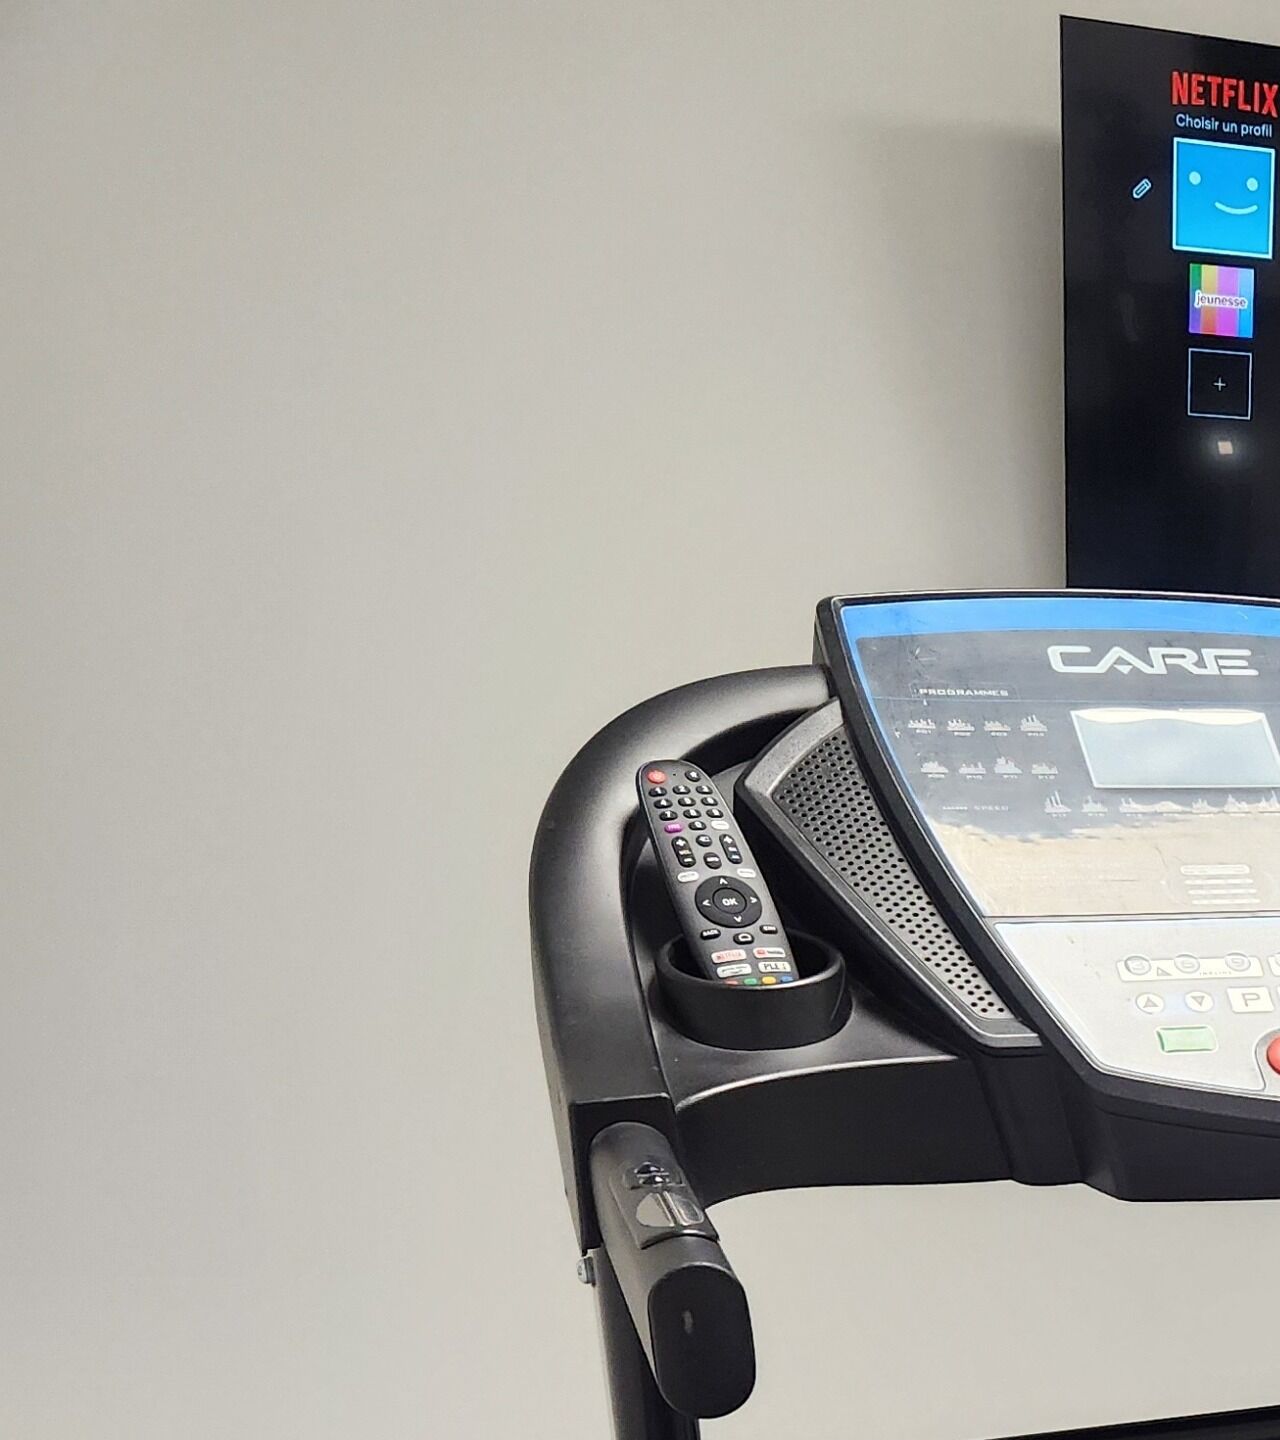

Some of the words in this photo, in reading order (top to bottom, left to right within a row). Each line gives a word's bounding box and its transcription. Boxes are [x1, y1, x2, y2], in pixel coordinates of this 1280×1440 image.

[1171, 71, 1279, 118] NETFLIX
[1176, 114, 1219, 131] Choisir
[1222, 121, 1238, 133] un
[1240, 124, 1273, 138] profil
[1196, 291, 1247, 307] jeunesse
[1047, 645, 1259, 676] CARE
[918, 688, 1009, 697] PROGRAMMES
[722, 898, 738, 906] OK
[1241, 992, 1260, 1007] P
